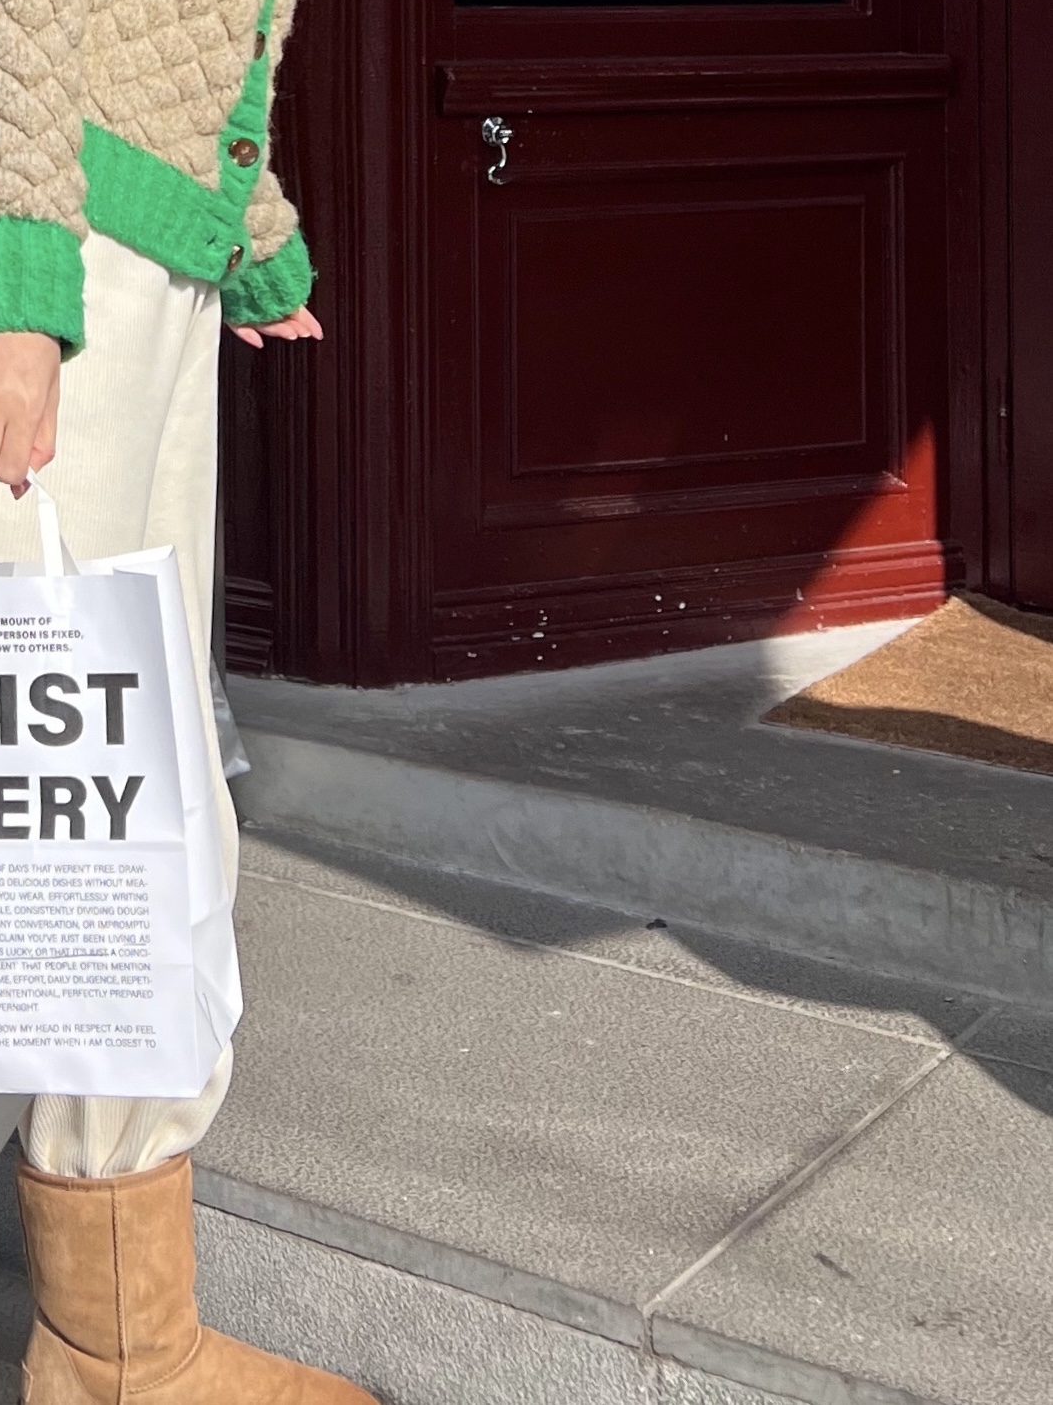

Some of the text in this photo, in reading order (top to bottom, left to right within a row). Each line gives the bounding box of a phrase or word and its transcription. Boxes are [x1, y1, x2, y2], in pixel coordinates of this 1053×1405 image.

[38, 617, 51, 626] OF
[38, 630, 48, 640] IS
[13, 643, 26, 653] TO
[8, 863, 29, 873] DAYS
[32, 863, 52, 873] THAT
[7, 877, 50, 887] DELICIOUS
[52, 878, 83, 887] DISHES
[85, 878, 123, 888] WITHOUT
[49, 892, 108, 902] EFFORTLESSLY
[112, 892, 148, 902] WRITING
[14, 905, 74, 915] CONSISTENTLY
[77, 905, 115, 916] DIVIDING
[117, 906, 150, 916] DOUGH
[0, 932, 25, 943] CLAIM
[61, 933, 79, 943] JUST
[83, 933, 106, 944] BEEN
[22, 960, 42, 970] THAT
[45, 960, 77, 971] PEOPLE
[80, 961, 108, 971] OFTEN
[47, 973, 71, 984] DAILY
[110, 989, 154, 999] PREPARED
[19, 1023, 33, 1033] MY
[36, 1023, 60, 1033] HEAD
[75, 1023, 111, 1034] RESPECT
[114, 1024, 134, 1034] AND
[13, 1037, 51, 1047] MOMENT
[54, 1037, 81, 1047] WHEN
[105, 1038, 141, 1048] CLOSEST
